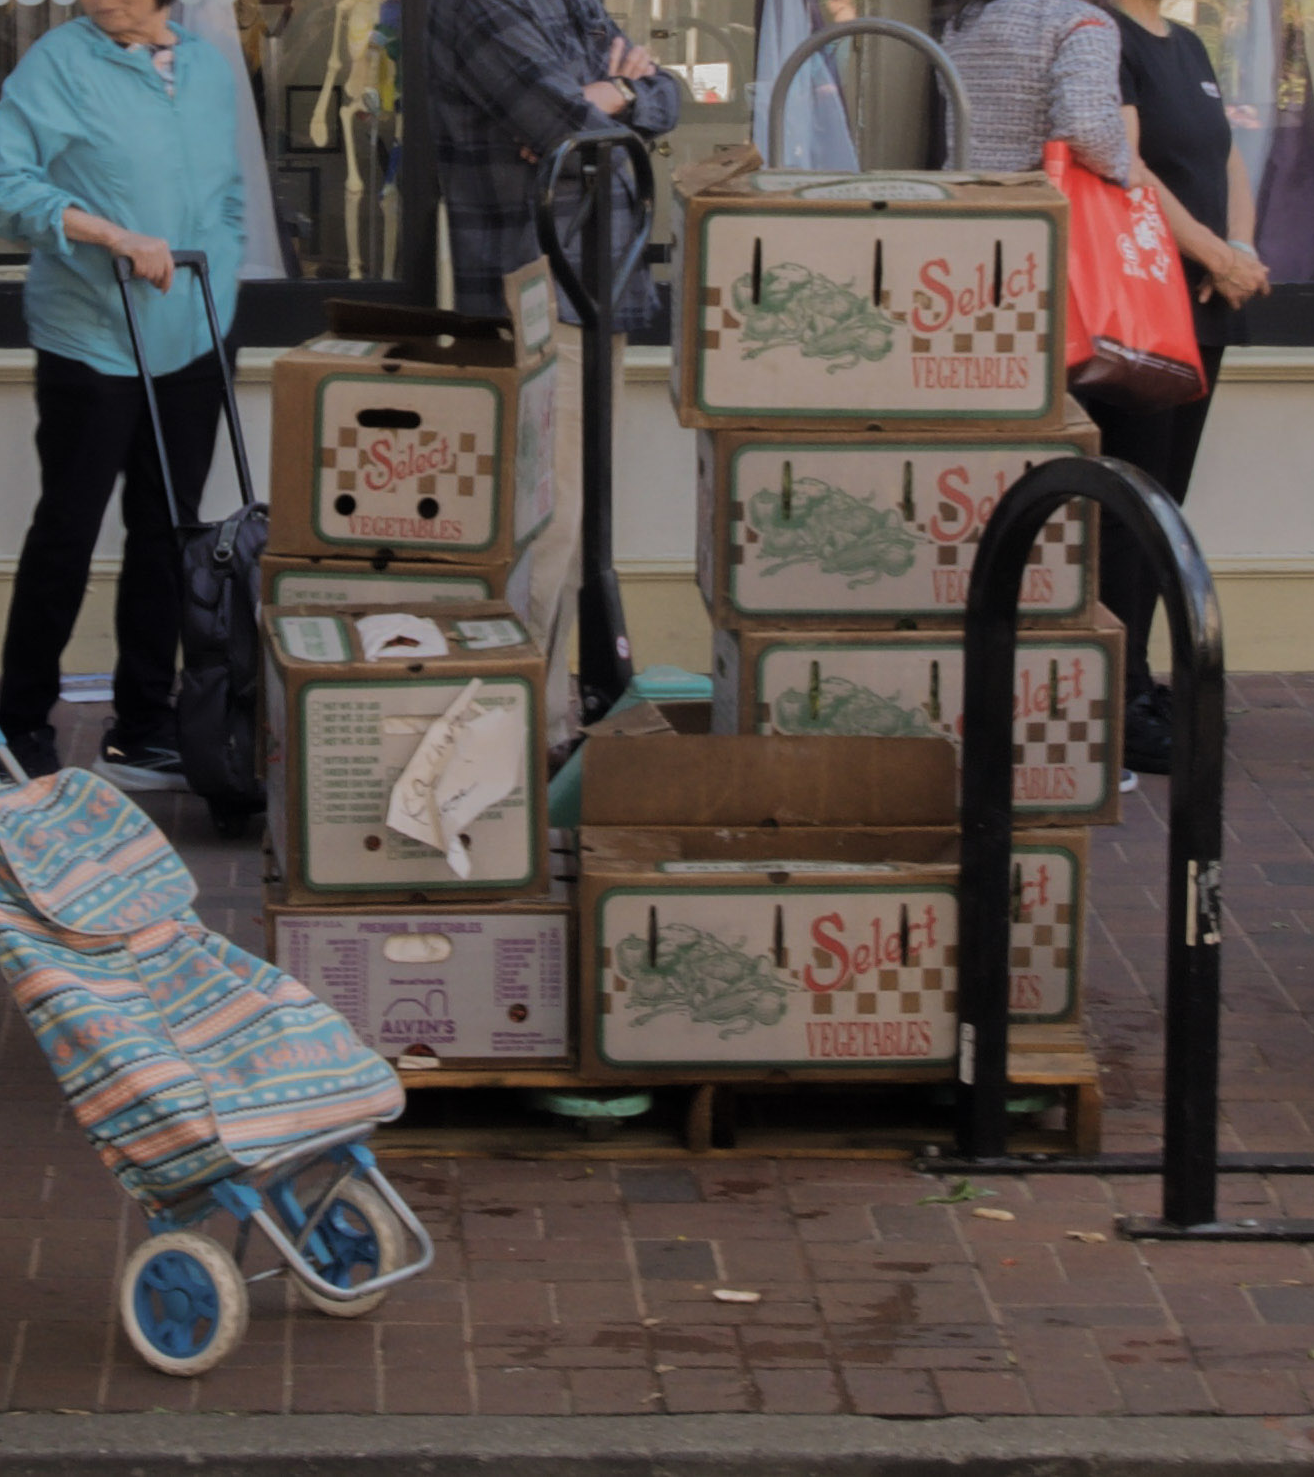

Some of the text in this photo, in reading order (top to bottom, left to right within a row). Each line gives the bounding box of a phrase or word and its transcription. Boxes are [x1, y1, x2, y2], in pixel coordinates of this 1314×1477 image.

[912, 357, 1030, 390] VEGETABLES
[364, 436, 450, 491] Select
[346, 515, 464, 541] VEGETABLES
[804, 904, 938, 993] Select
[380, 1019, 456, 1035] ALVIN'S
[804, 1020, 933, 1058] VEGETABLES
